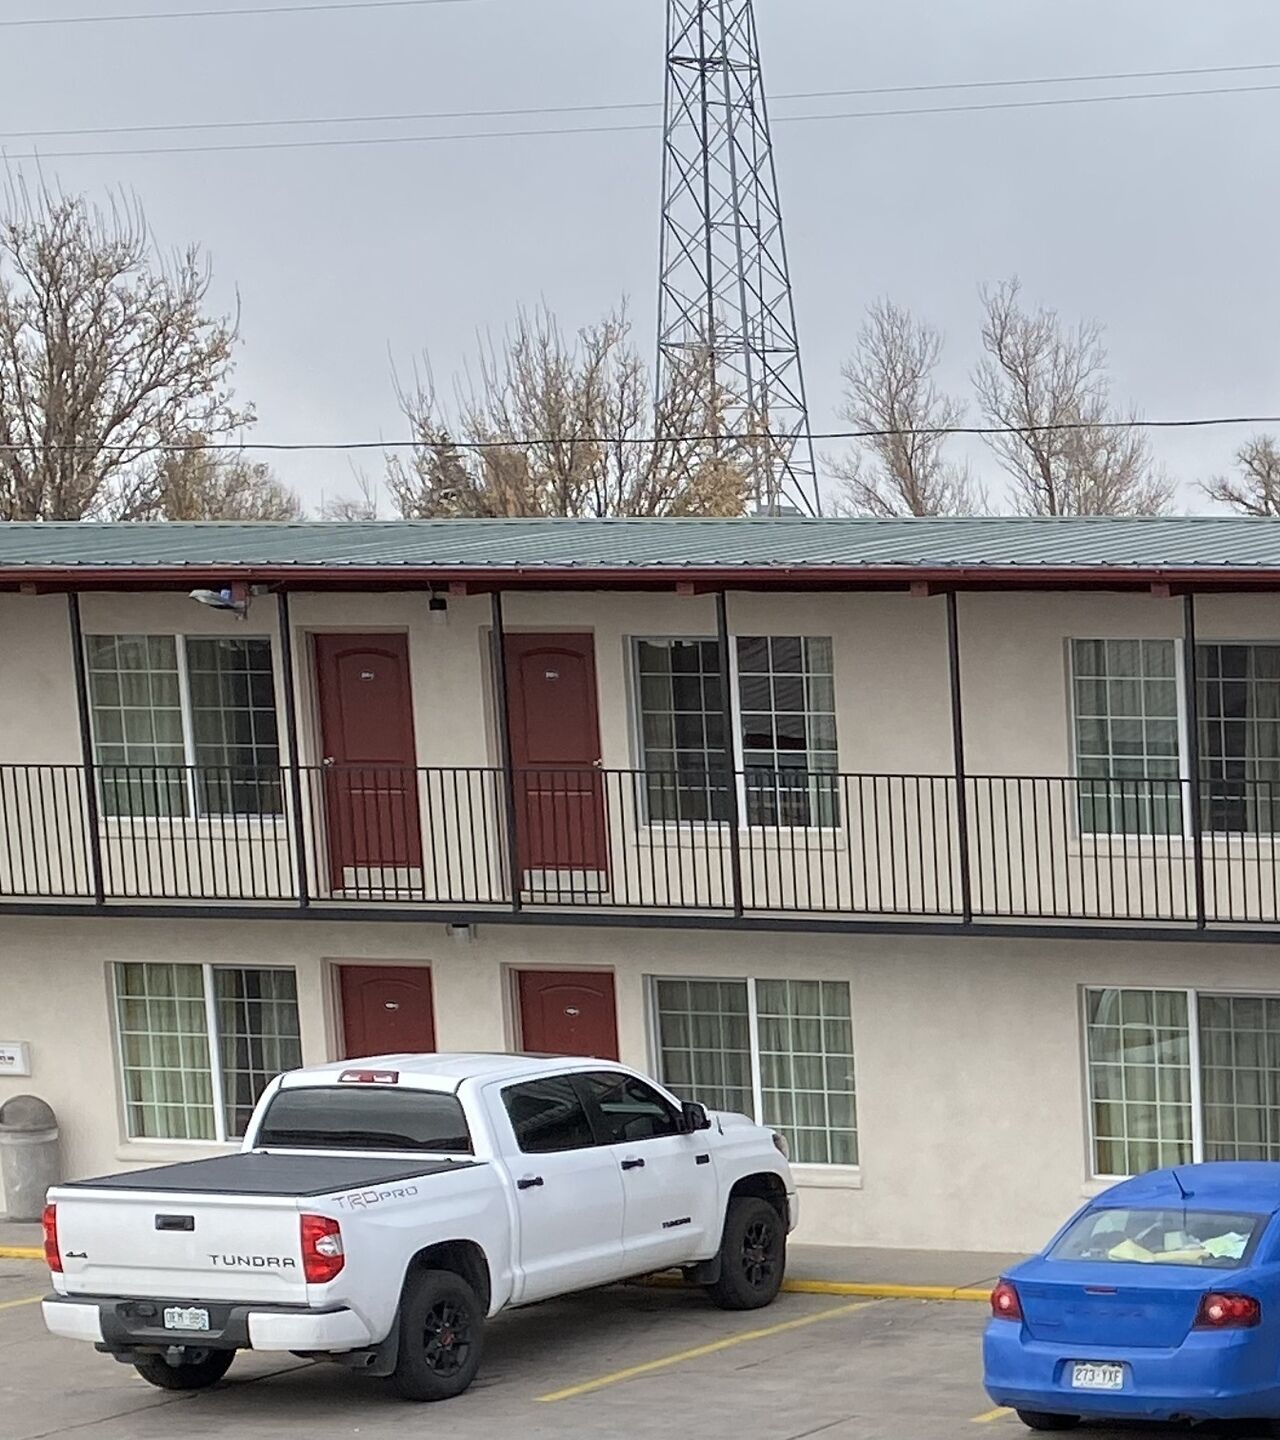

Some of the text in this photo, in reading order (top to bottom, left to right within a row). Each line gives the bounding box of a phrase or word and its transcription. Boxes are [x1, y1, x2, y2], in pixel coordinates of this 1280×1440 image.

[332, 1186, 418, 1209] TRD PRO
[209, 1254, 296, 1268] TUNDRA
